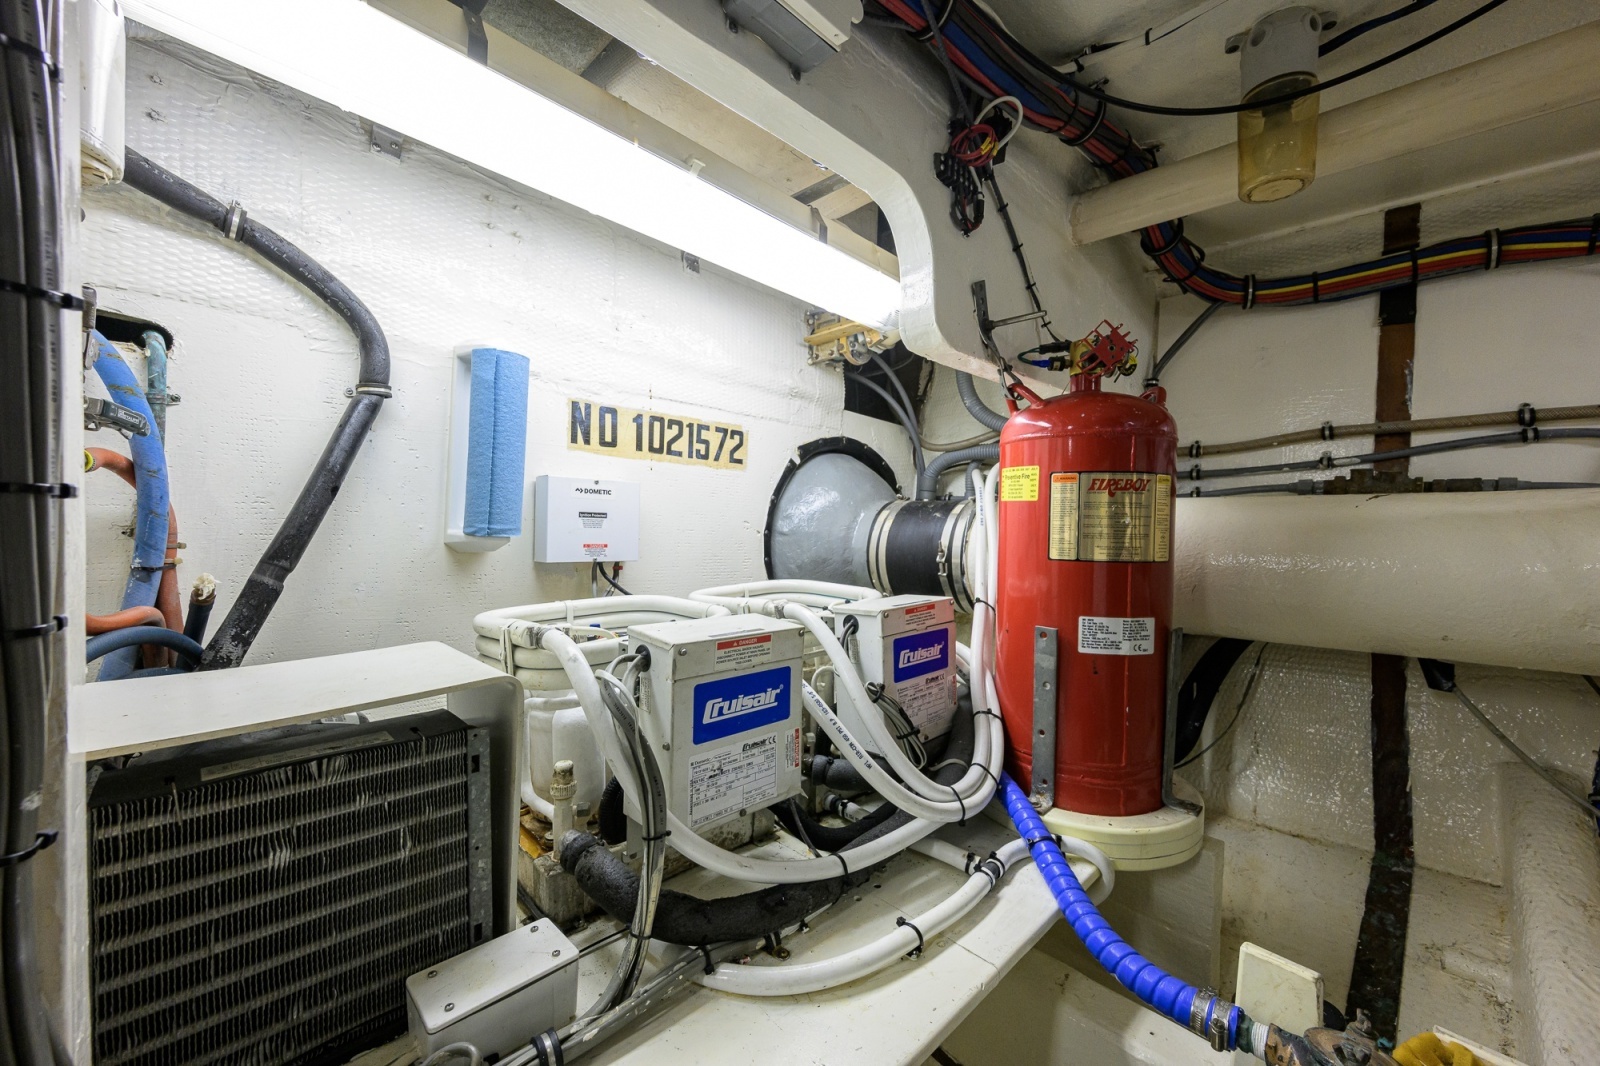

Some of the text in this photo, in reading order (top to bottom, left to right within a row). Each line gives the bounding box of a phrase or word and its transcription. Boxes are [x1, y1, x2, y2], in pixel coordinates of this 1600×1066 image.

[570, 400, 744, 465] NO 1021572
[584, 488, 612, 496] DOMETIC
[1088, 478, 1152, 498] FIREBOY
[899, 643, 943, 668] Cruisair
[702, 686, 781, 724] Cruisair
